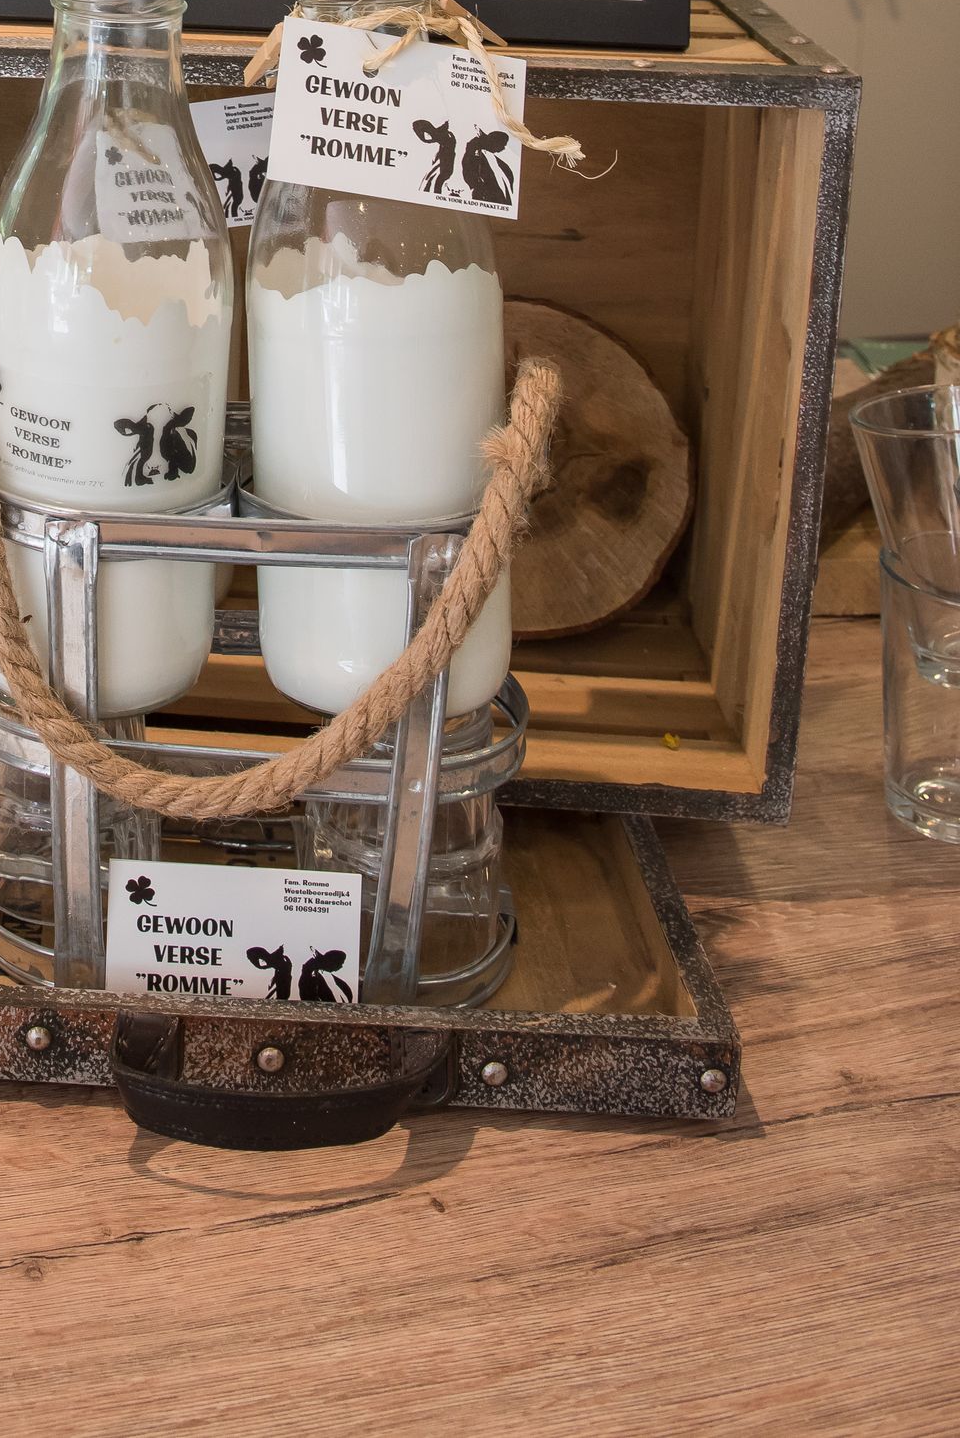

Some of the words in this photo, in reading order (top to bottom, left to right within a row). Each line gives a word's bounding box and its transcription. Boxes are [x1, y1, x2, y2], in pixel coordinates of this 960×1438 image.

[452, 54, 469, 63] Fam.
[450, 71, 469, 81] 5087
[470, 75, 480, 83] TK
[450, 80, 461, 88] 06
[461, 82, 492, 93] 1069439
[305, 74, 402, 108] GEWOON
[320, 106, 389, 136] VERSE
[300, 134, 409, 168] ”ROMME”
[463, 199, 479, 207] KADO
[10, 406, 71, 432] GEWOON
[14, 426, 61, 449] VERSE
[6, 441, 73, 469] “ROMME”
[284, 878, 301, 887] Fam.
[302, 879, 330, 888] Romme
[295, 905, 330, 914] 10694391
[303, 897, 314, 905] TK
[315, 898, 352, 907] Baarschot
[136, 914, 234, 938] GEWOON
[153, 944, 223, 967] VERSE
[135, 972, 244, 997] ”ROMME”
